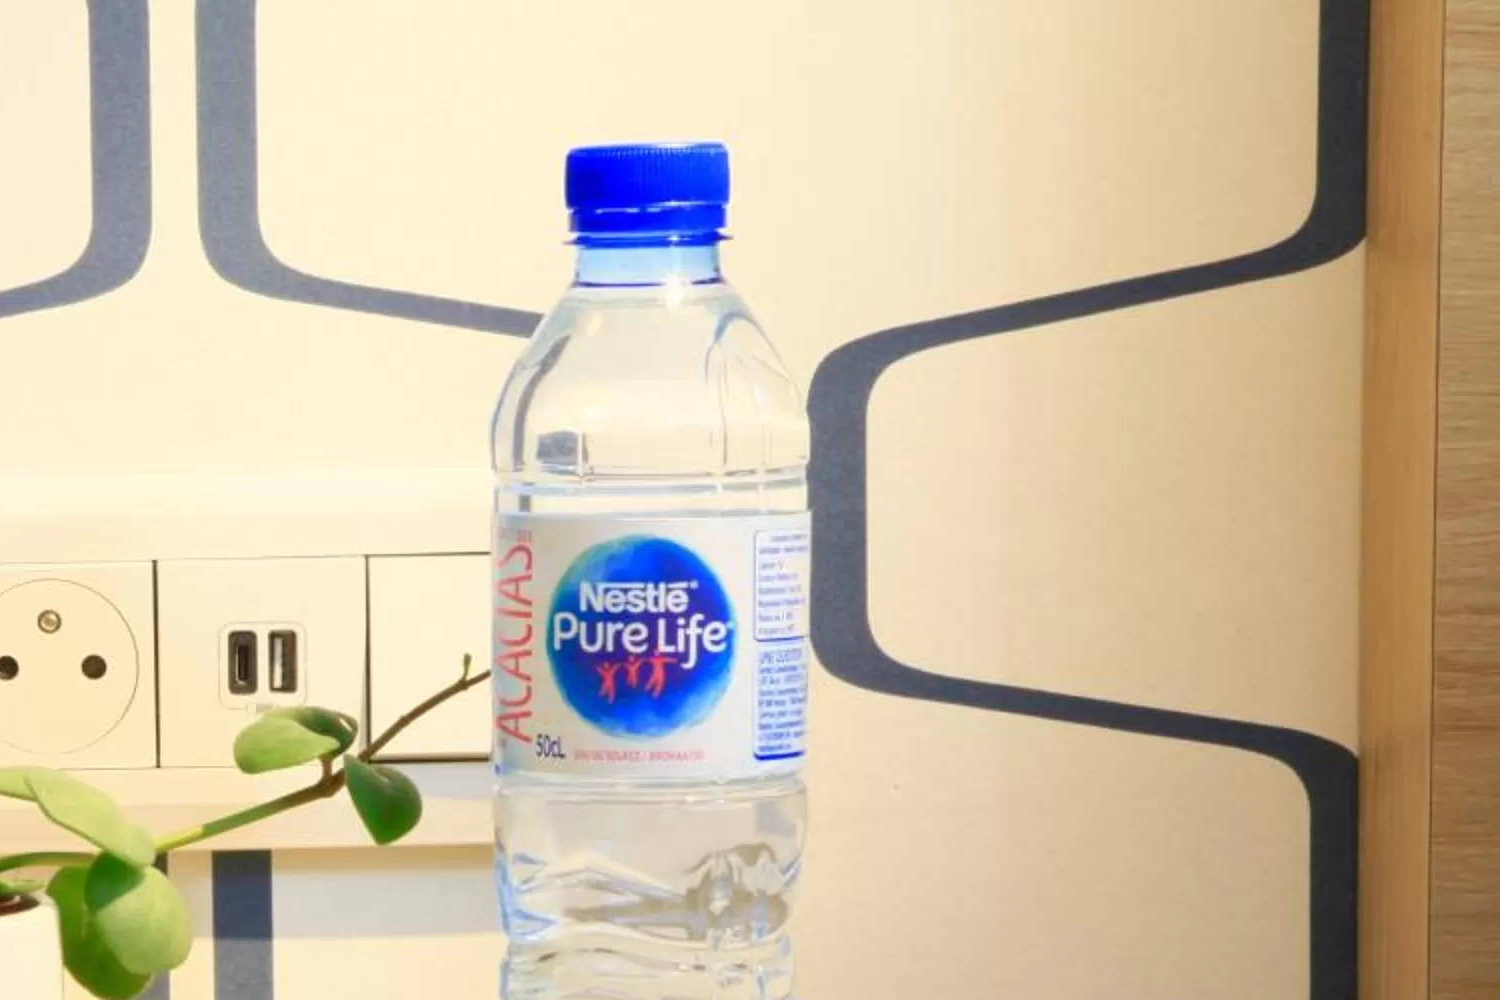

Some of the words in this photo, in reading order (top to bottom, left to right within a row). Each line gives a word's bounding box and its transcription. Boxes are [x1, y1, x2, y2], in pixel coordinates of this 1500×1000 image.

[579, 581, 690, 613] Nestlé
[495, 543, 533, 744] ACACIAS
[553, 611, 649, 654] Pure
[656, 614, 729, 670] Life
